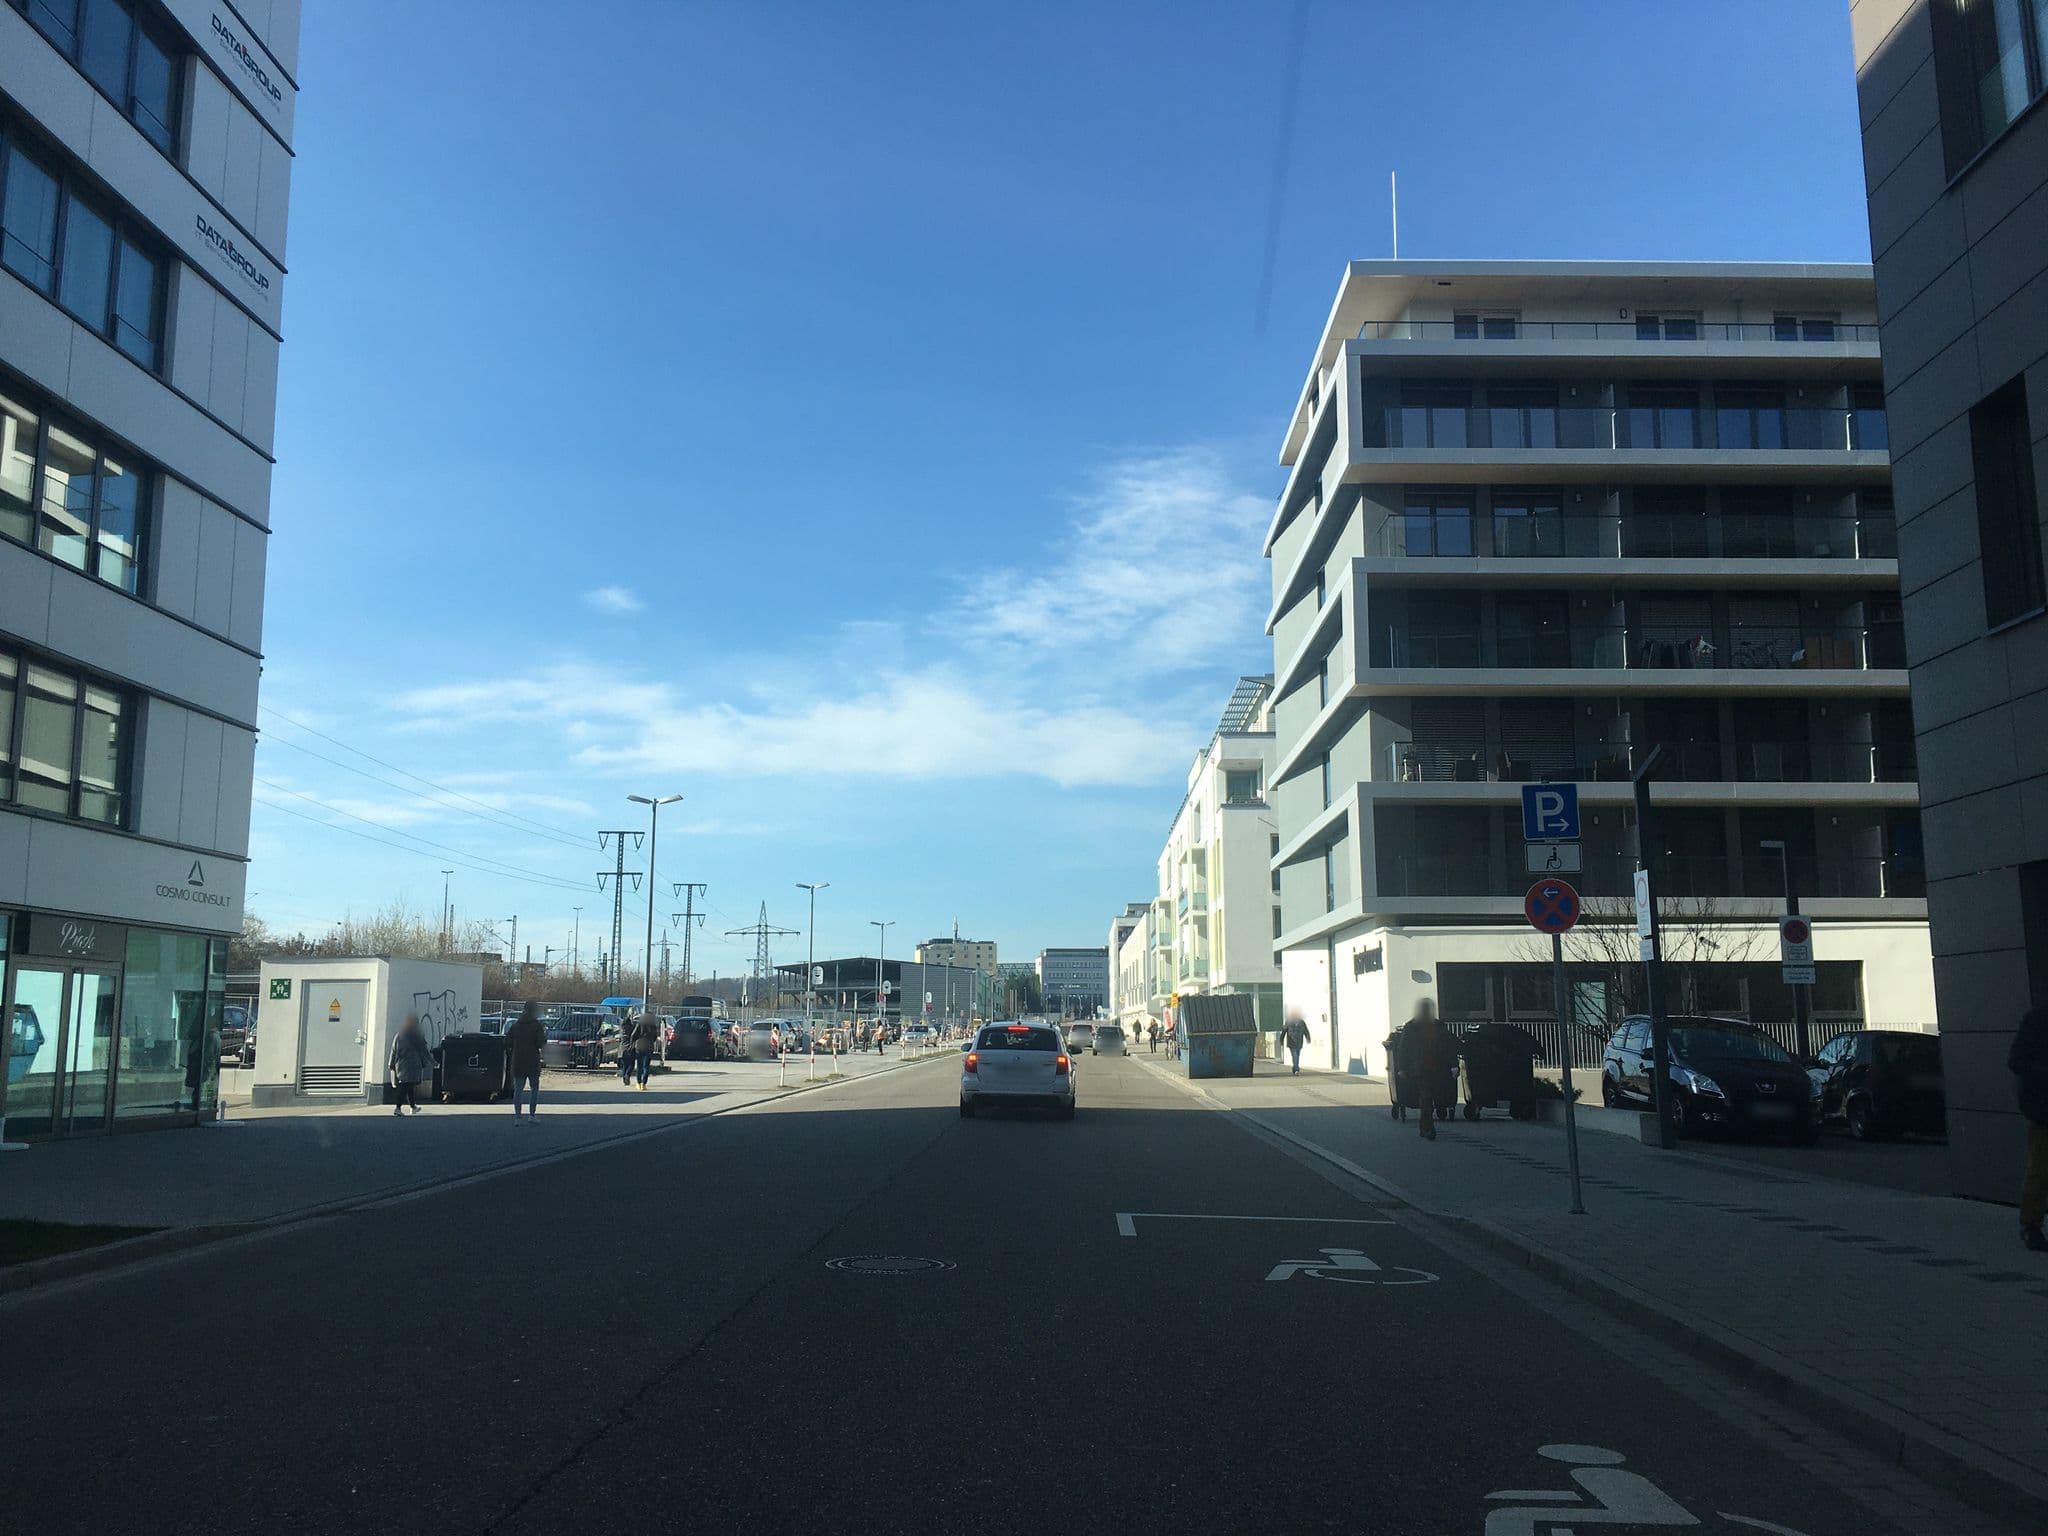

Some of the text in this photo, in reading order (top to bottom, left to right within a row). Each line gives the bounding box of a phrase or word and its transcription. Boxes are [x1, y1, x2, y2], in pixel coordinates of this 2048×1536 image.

[212, 13, 282, 101] DATAGROUP
[196, 214, 269, 289] DATAGROUP
[1535, 791, 1565, 832] P
[156, 884, 232, 907] COSMO CONSULT
